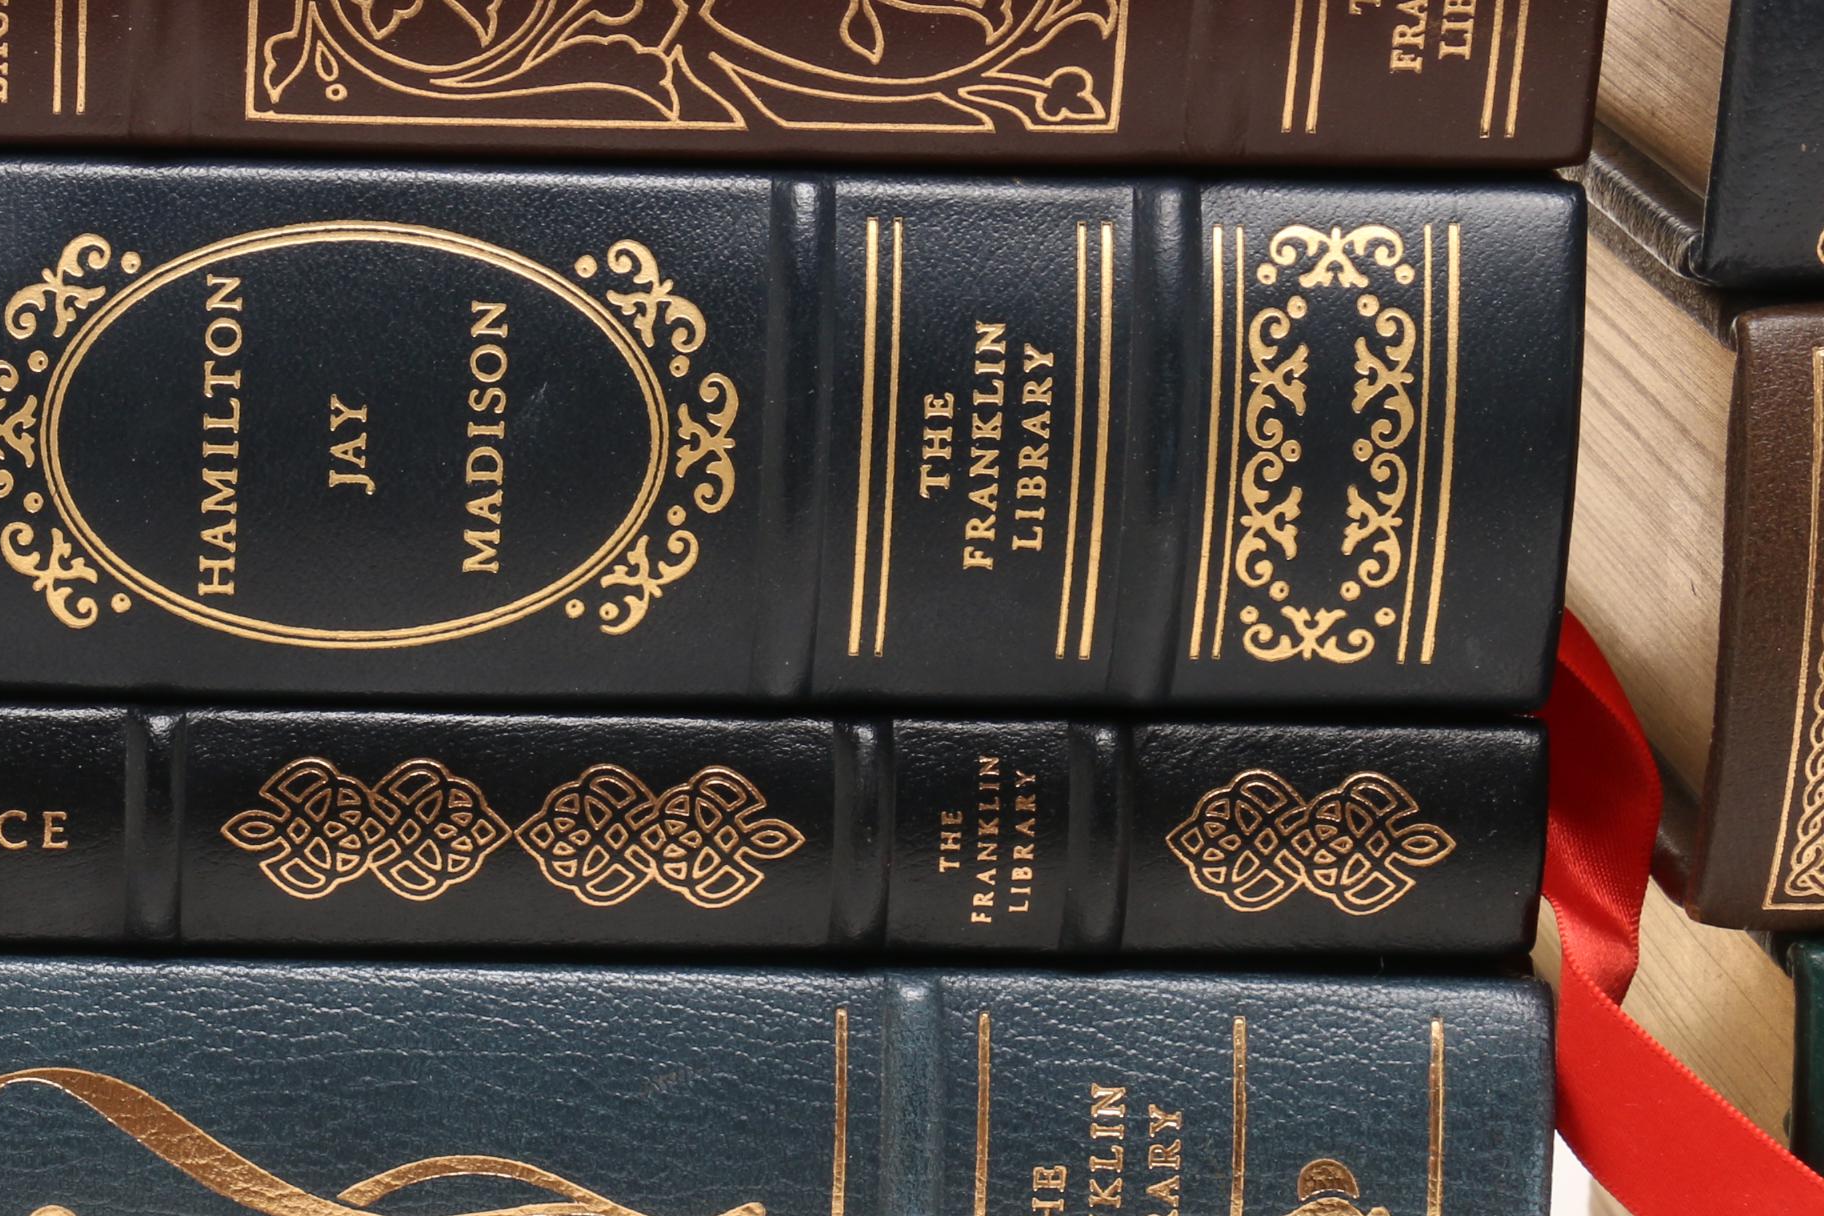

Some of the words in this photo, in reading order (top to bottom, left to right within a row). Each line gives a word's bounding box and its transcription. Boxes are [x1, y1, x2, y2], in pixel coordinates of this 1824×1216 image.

[198, 274, 243, 597] HAMILTON
[329, 393, 376, 495] JAY
[462, 300, 509, 573] MADISON
[919, 391, 955, 499] THE
[962, 320, 1007, 571] FRANKLIN
[1011, 343, 1055, 552] LIBRARY
[938, 810, 963, 873] THE
[970, 755, 1001, 924] FRANKLIN
[1008, 770, 1037, 913] LIBRARY
